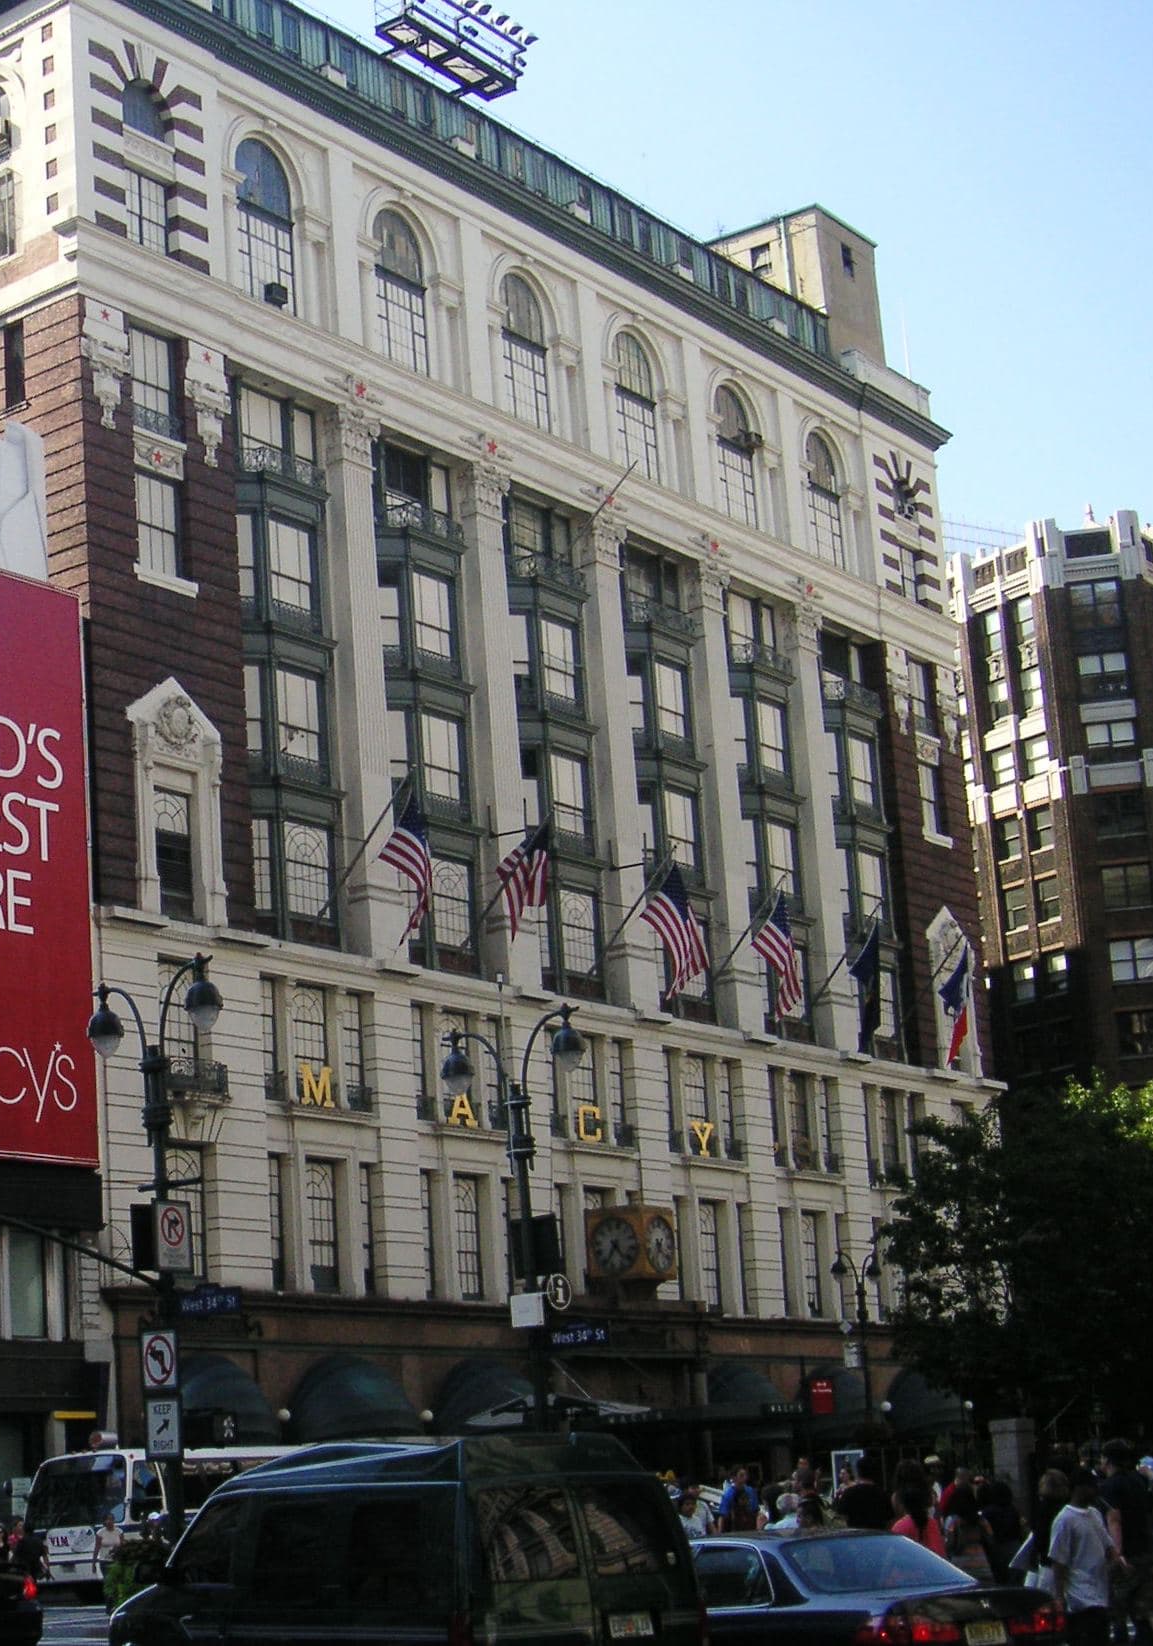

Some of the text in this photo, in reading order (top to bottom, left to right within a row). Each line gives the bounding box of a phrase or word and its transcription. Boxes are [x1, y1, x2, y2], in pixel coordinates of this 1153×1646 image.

[594, 1328, 606, 1340] St
[153, 1404, 172, 1415] KEEP
[153, 1439, 176, 1451] RIGHT
